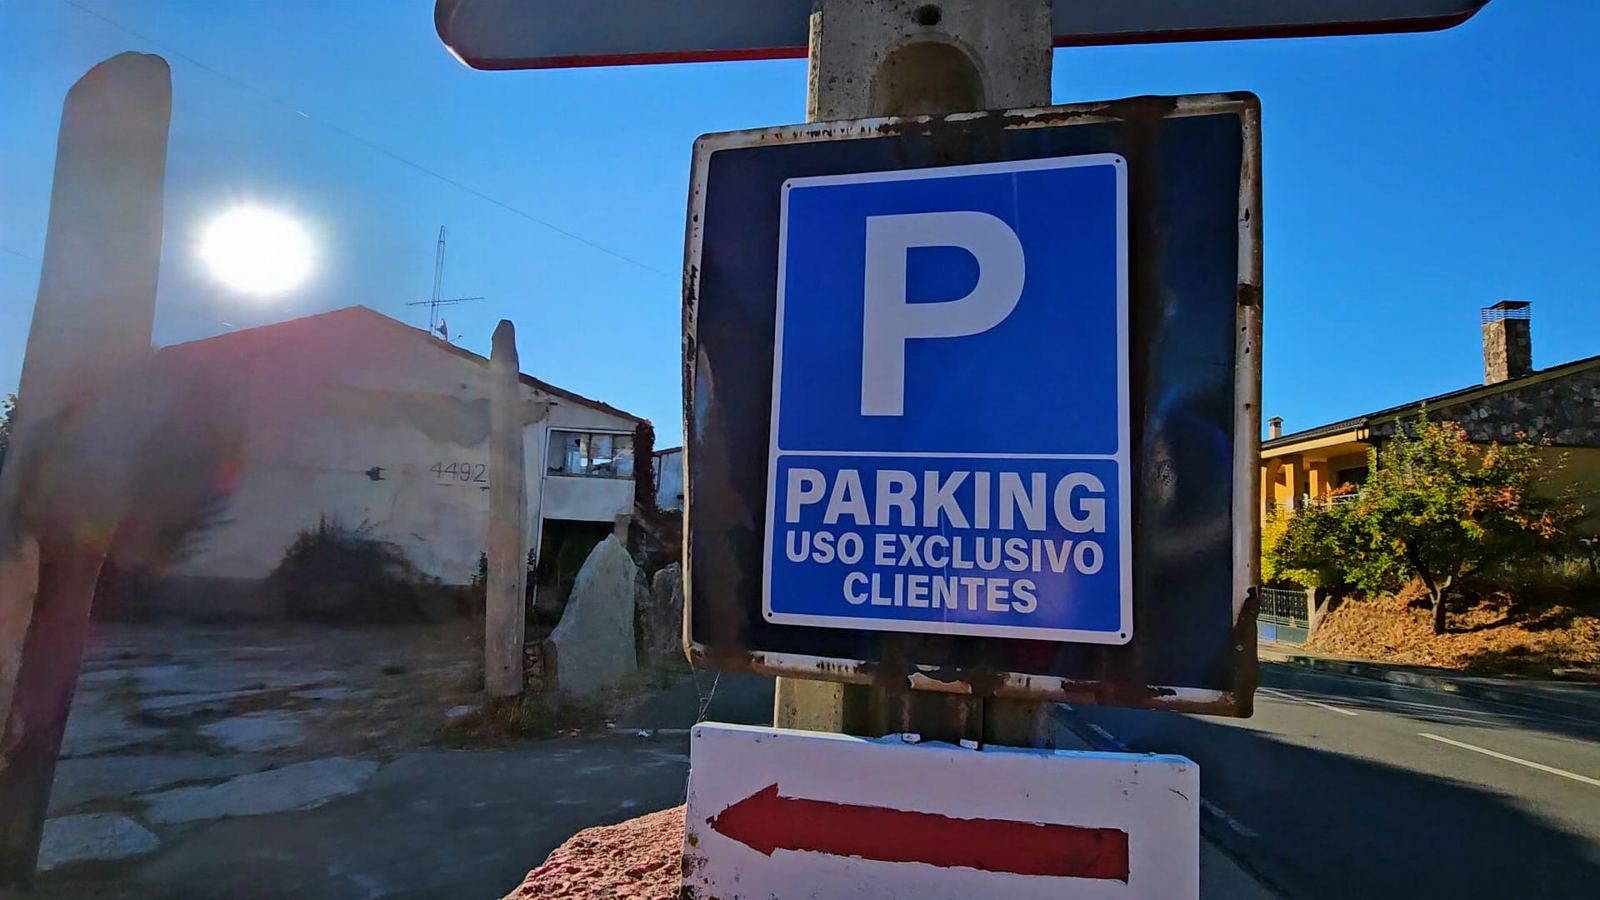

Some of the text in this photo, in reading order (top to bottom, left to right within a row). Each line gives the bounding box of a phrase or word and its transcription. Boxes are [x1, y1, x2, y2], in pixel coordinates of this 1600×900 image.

[861, 211, 1026, 416] P
[430, 461, 486, 482] 4492
[785, 467, 1106, 533] PARKING
[786, 530, 1104, 575] USO EXCLUSIVO
[843, 571, 1037, 614] CLIENTES
